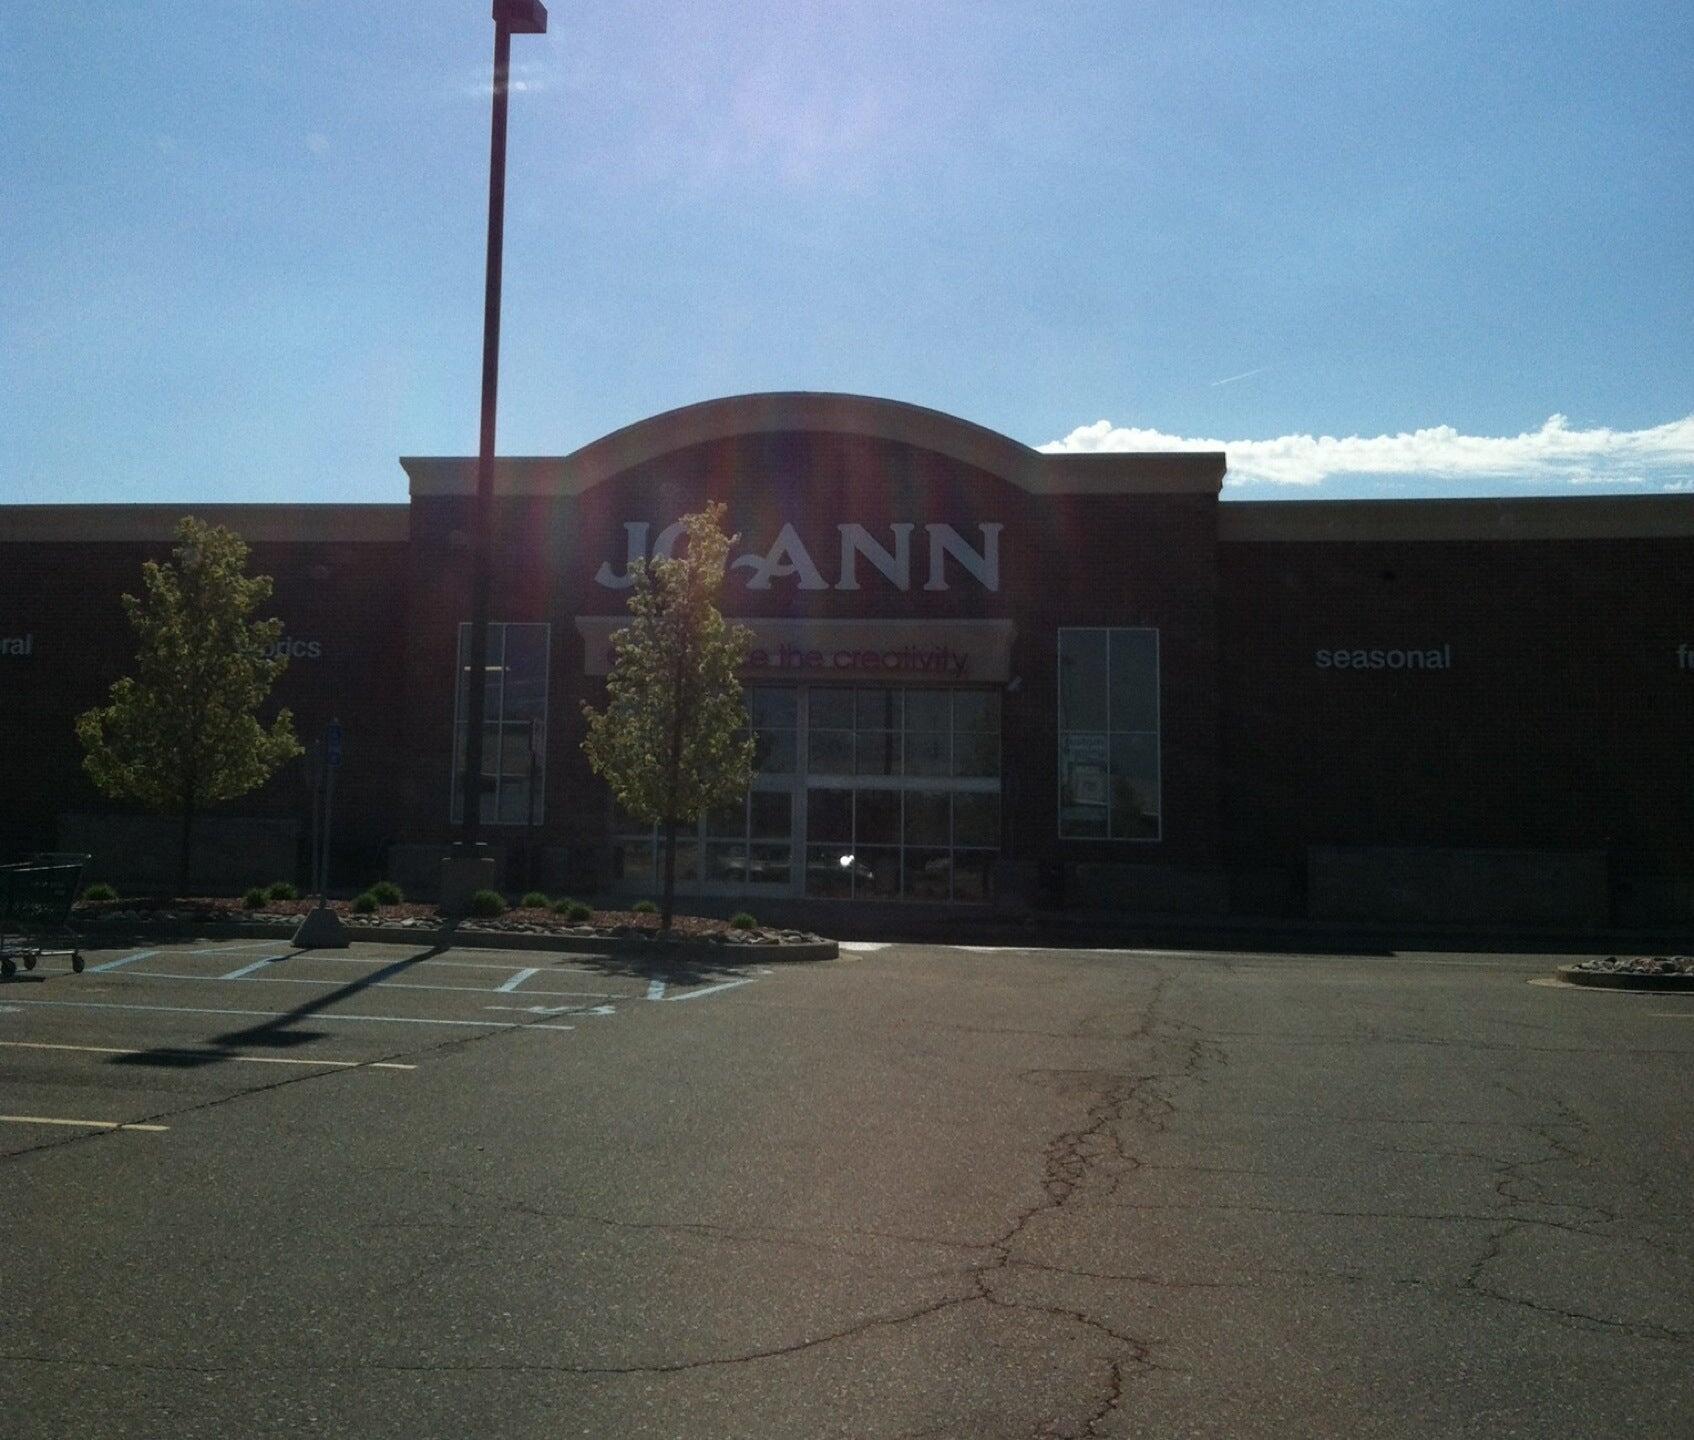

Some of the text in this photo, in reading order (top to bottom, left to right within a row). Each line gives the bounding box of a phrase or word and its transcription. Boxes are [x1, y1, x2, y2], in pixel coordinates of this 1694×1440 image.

[780, 644, 824, 669] the
[832, 645, 969, 678] creativity
[1315, 643, 1452, 670] seasonal
